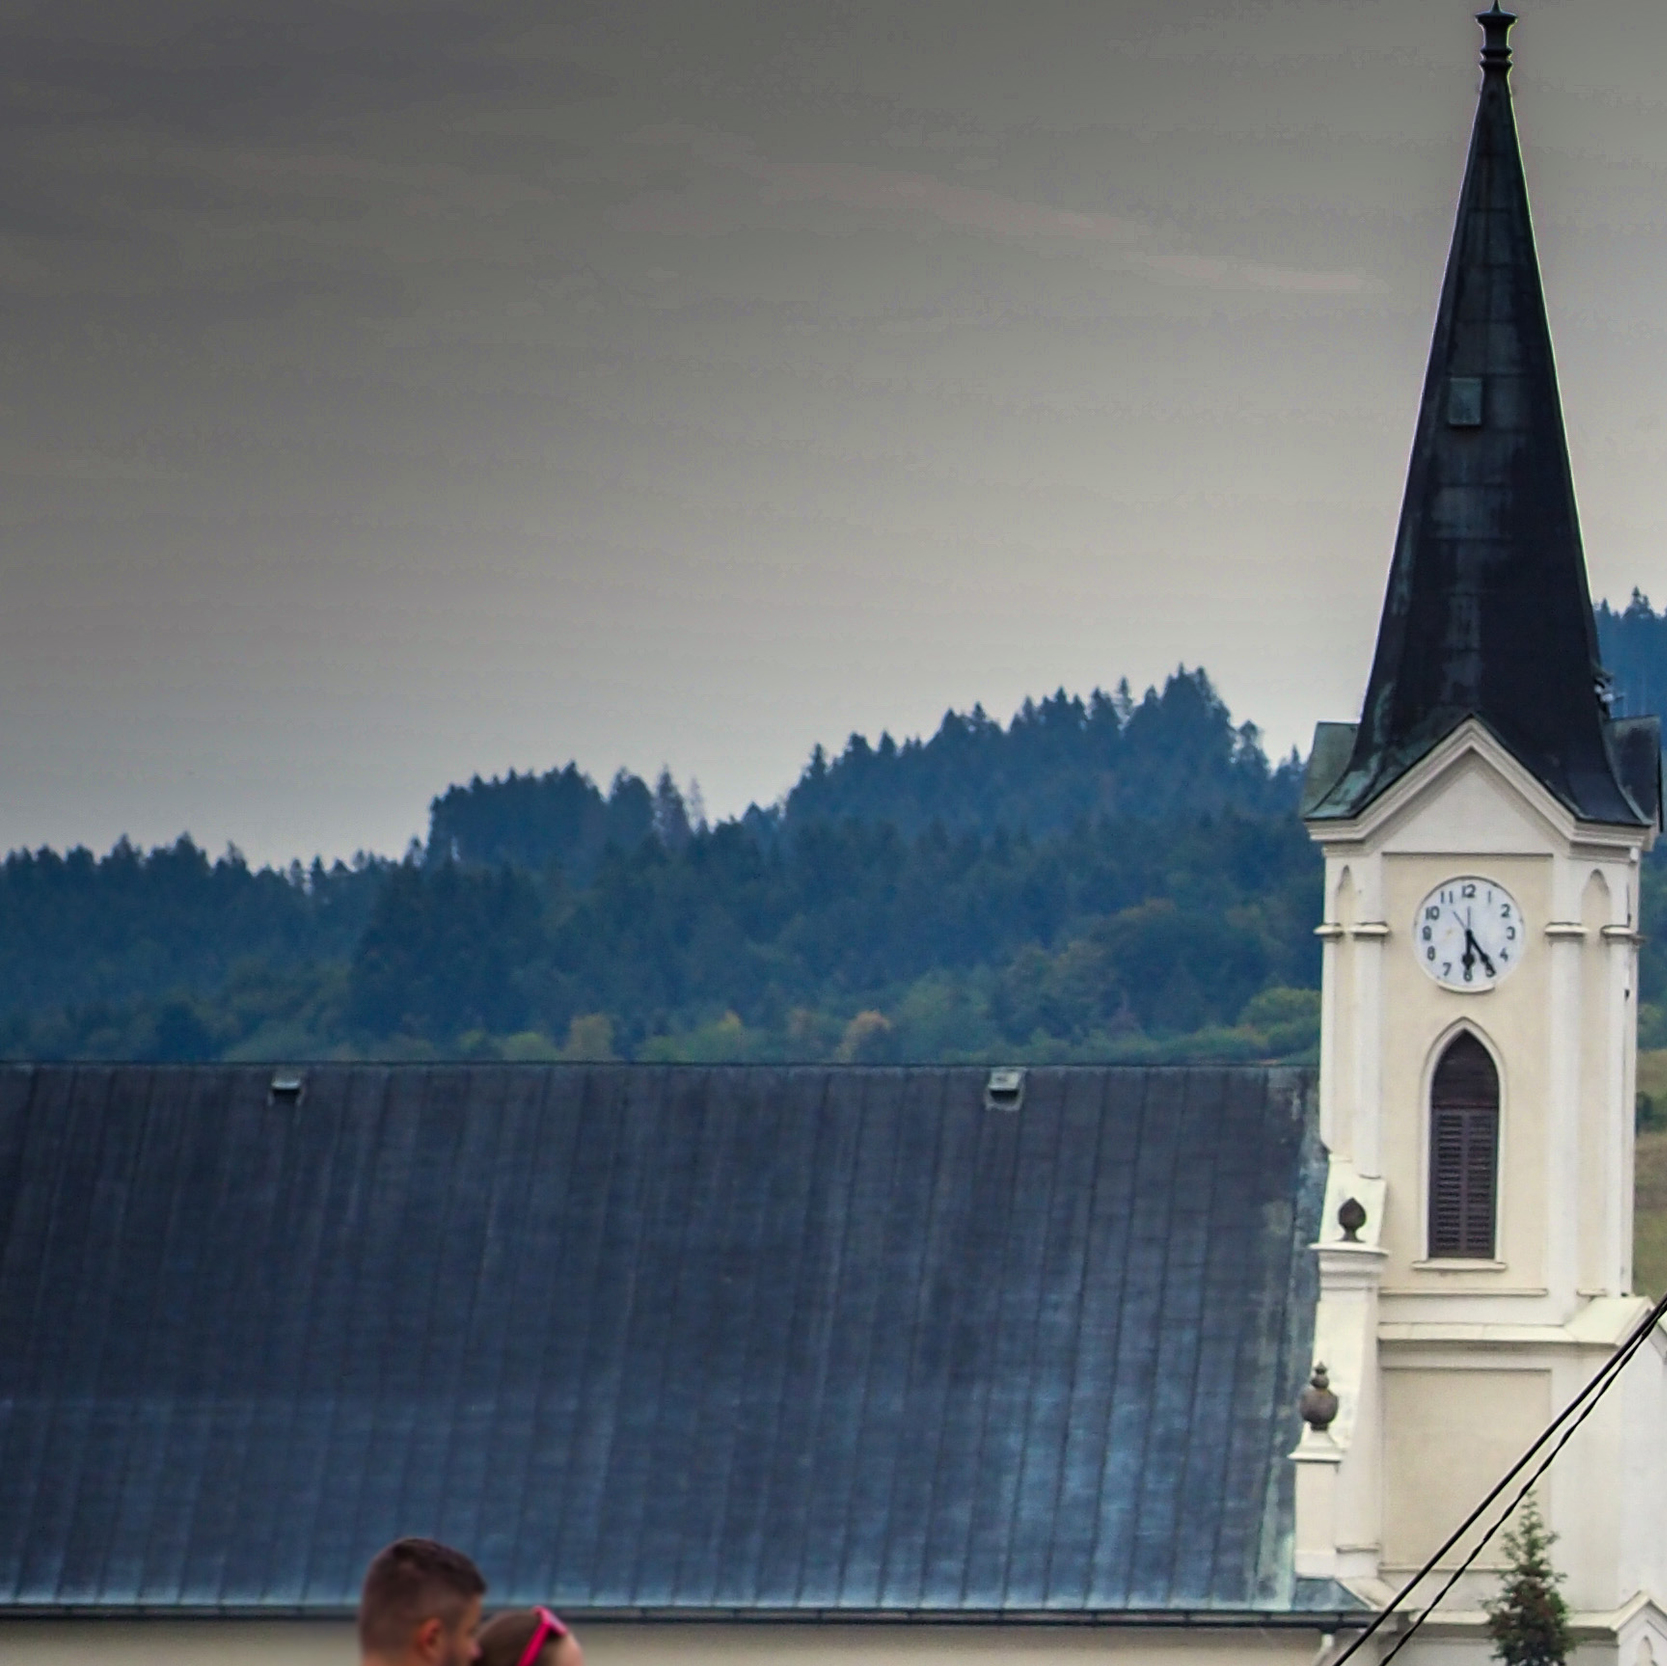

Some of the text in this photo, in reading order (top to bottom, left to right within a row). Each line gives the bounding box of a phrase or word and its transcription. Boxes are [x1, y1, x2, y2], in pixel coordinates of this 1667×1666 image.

[1461, 884, 1476, 898] 12
[1425, 905, 1440, 920] 10
[1500, 903, 1511, 918] 2
[1499, 947, 1509, 962] 4
[1442, 962, 1452, 977] 7
